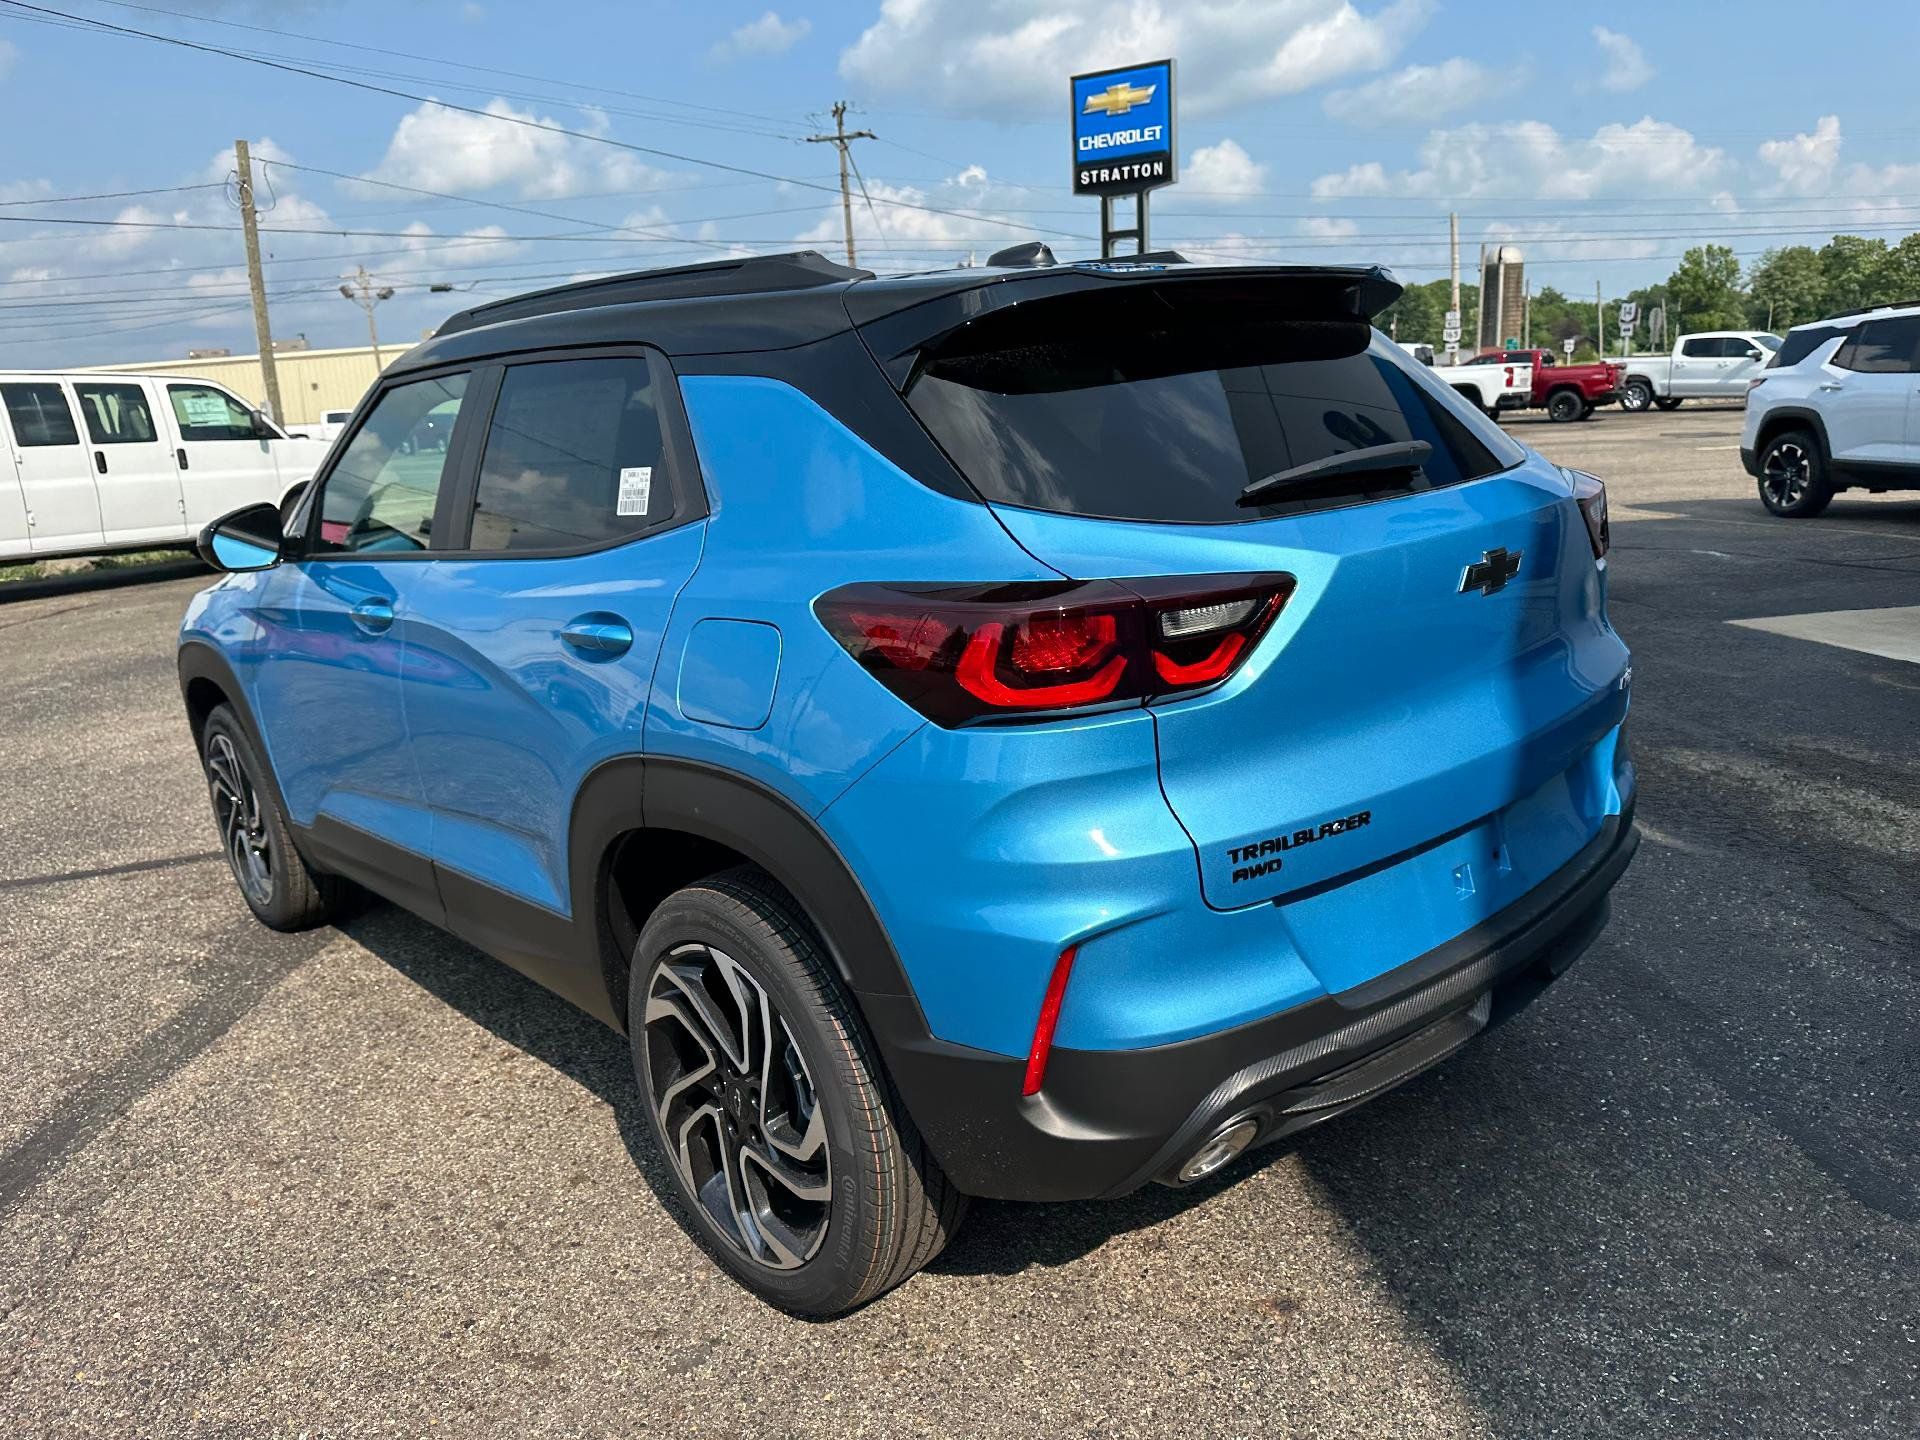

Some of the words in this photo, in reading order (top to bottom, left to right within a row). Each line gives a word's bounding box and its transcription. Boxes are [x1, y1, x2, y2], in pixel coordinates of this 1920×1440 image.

[1079, 125, 1163, 151] CHEVROLET
[1080, 161, 1164, 185] STRATTON
[1227, 810, 1372, 864] TRAILBLAZER
[1232, 858, 1283, 884] AWD
